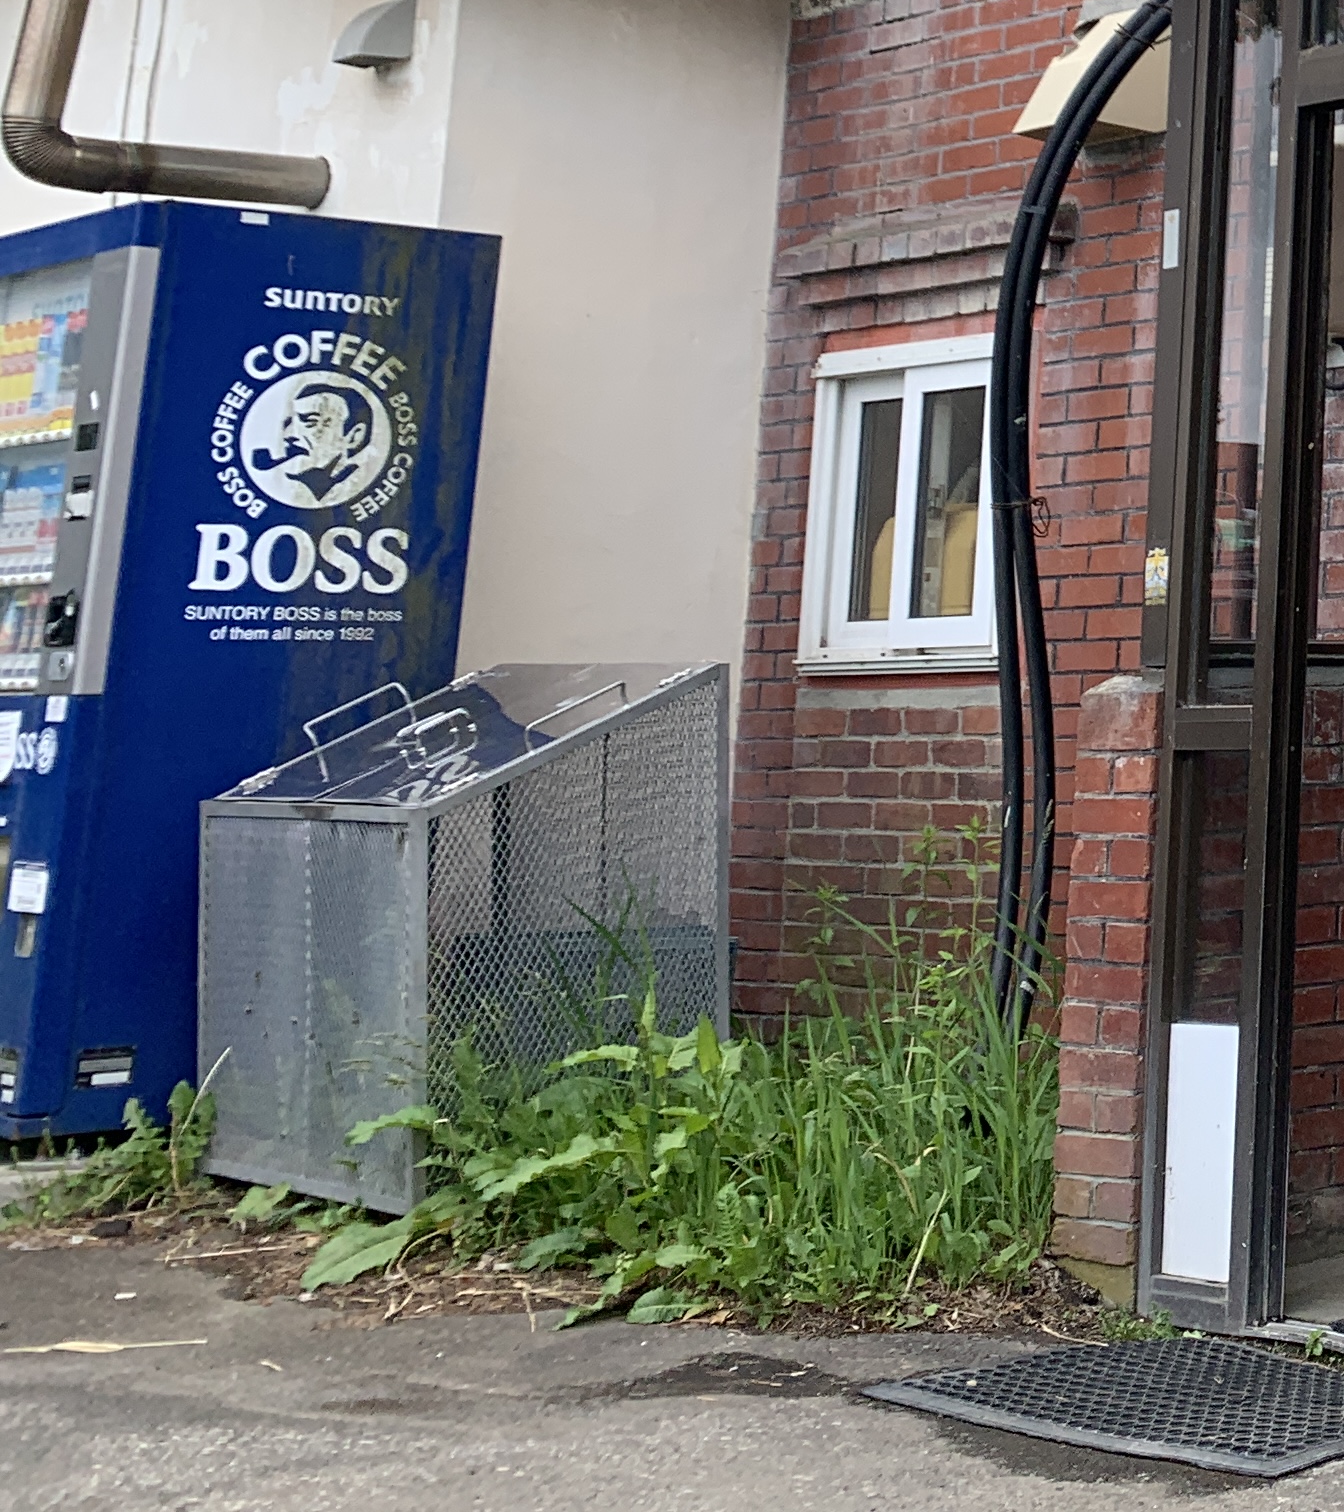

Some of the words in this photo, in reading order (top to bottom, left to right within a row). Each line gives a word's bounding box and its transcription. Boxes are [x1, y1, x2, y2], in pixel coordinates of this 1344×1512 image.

[243, 330, 408, 391] COFFEE
[211, 381, 254, 463] COFFEE
[388, 391, 418, 447] BOSS
[217, 466, 268, 519] BOSS
[350, 452, 413, 521] COFFEE
[188, 523, 410, 594] BOSS
[184, 605, 270, 621] SUNTORY
[273, 606, 320, 621] BOSS
[324, 607, 336, 621] is
[340, 608, 363, 621] the
[367, 608, 403, 622] boss
[210, 626, 228, 641] of
[230, 626, 269, 641] them
[271, 627, 292, 641] all
[294, 627, 334, 641] since
[339, 627, 374, 641] 1992
